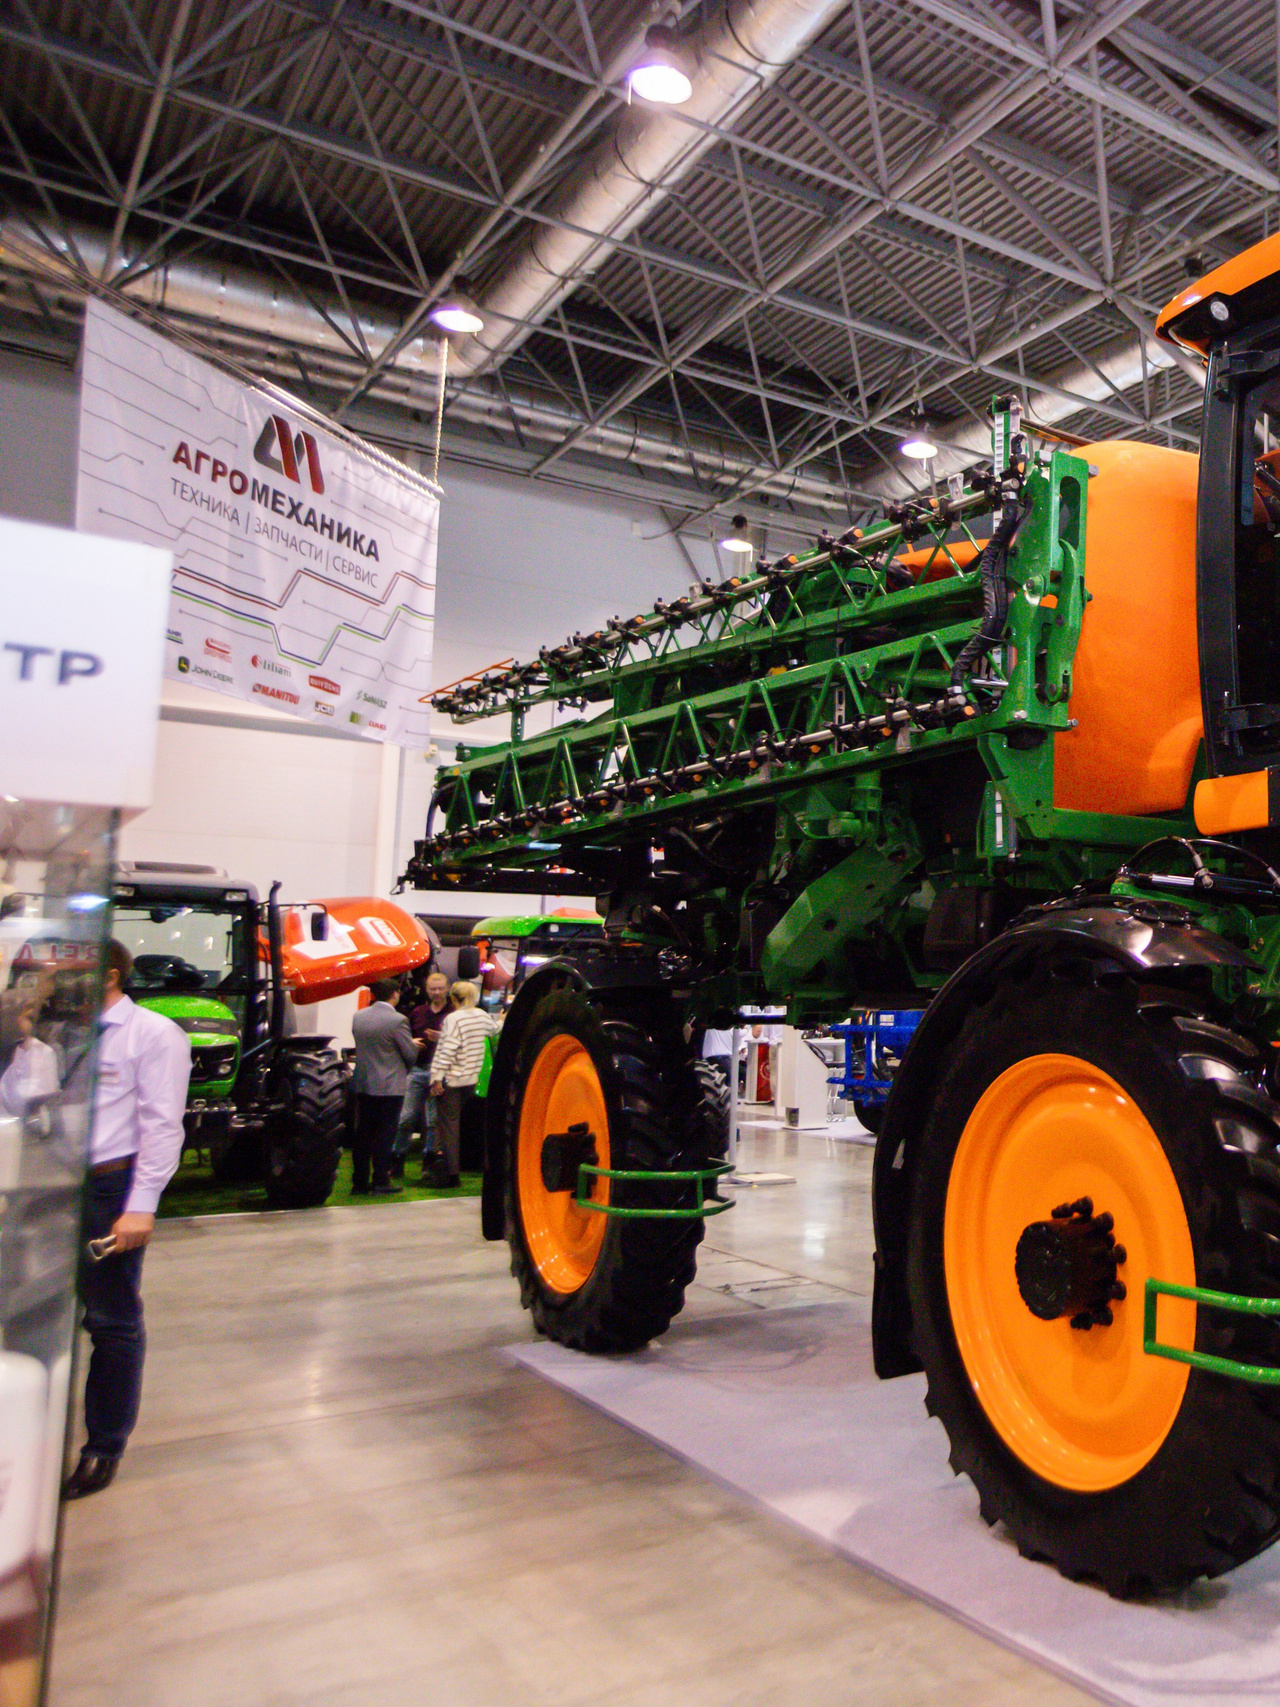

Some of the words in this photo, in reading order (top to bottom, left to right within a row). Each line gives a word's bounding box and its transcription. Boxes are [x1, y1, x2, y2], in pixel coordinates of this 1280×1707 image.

[172, 440, 380, 563] АГРОМЕХАНИКА
[171, 477, 240, 526] ТЕХНИКА
[254, 516, 323, 563] ЗАПЧАСТИ
[332, 555, 379, 589] СЕРВИС
[191, 664, 213, 678] JOHN
[260, 684, 300, 705] MANITOU
[314, 702, 334, 716] JCB
